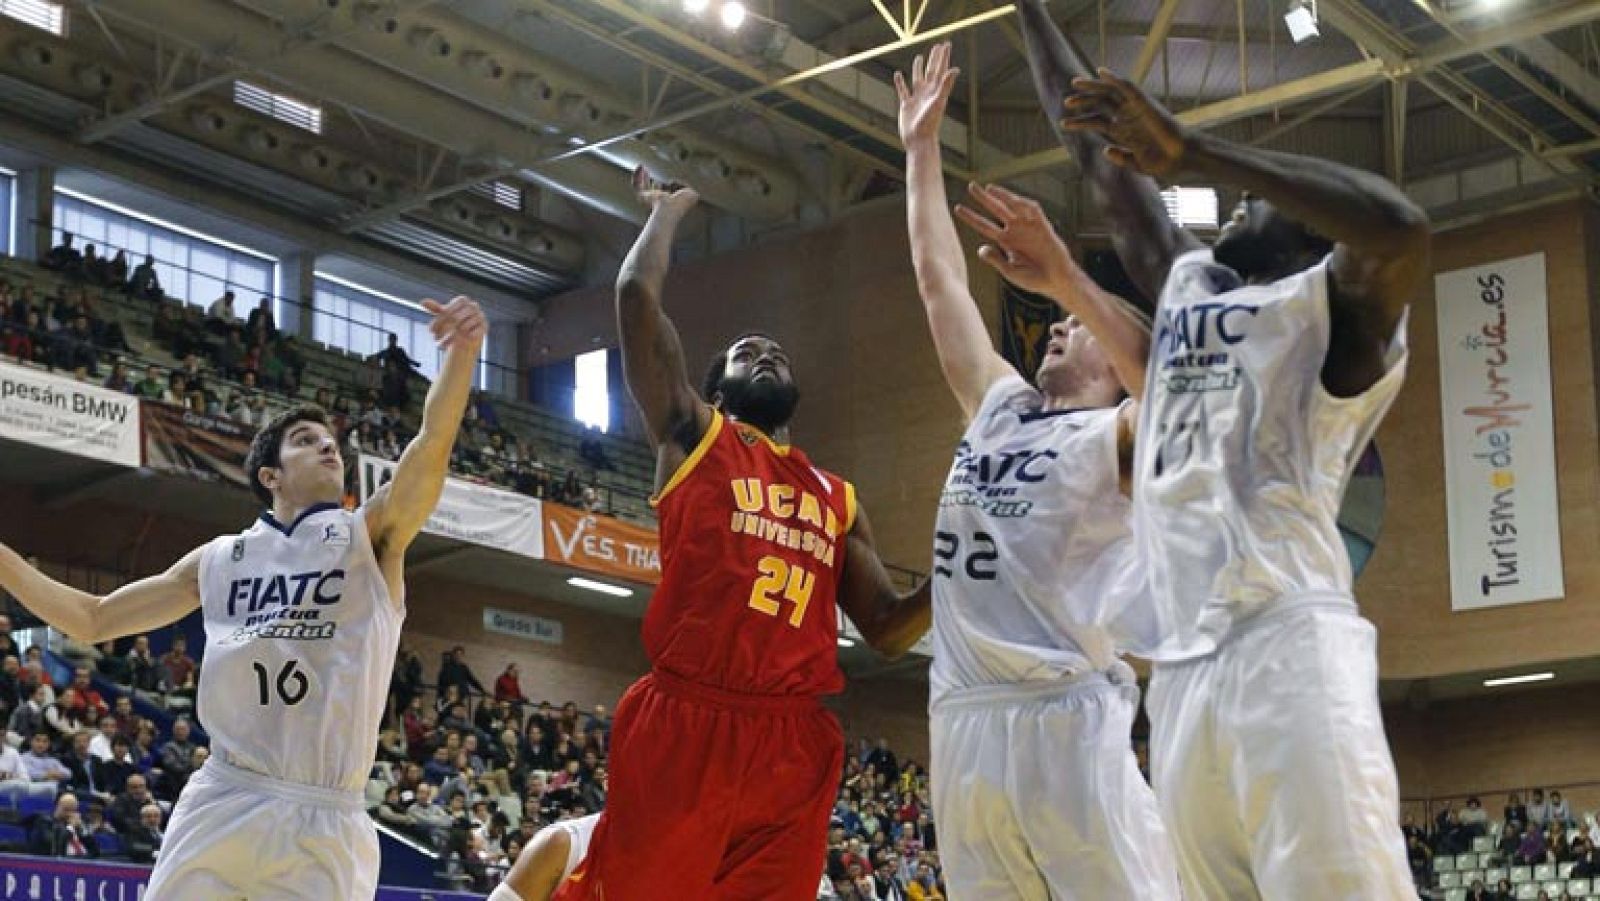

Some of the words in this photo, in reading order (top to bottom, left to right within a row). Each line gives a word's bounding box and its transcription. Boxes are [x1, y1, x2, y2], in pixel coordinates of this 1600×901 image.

[1, 379, 68, 410] pesán
[72, 391, 127, 424] BMW
[934, 530, 999, 580] 22
[227, 568, 346, 617] FIATC
[748, 555, 816, 629] 24
[253, 659, 310, 706] 16
